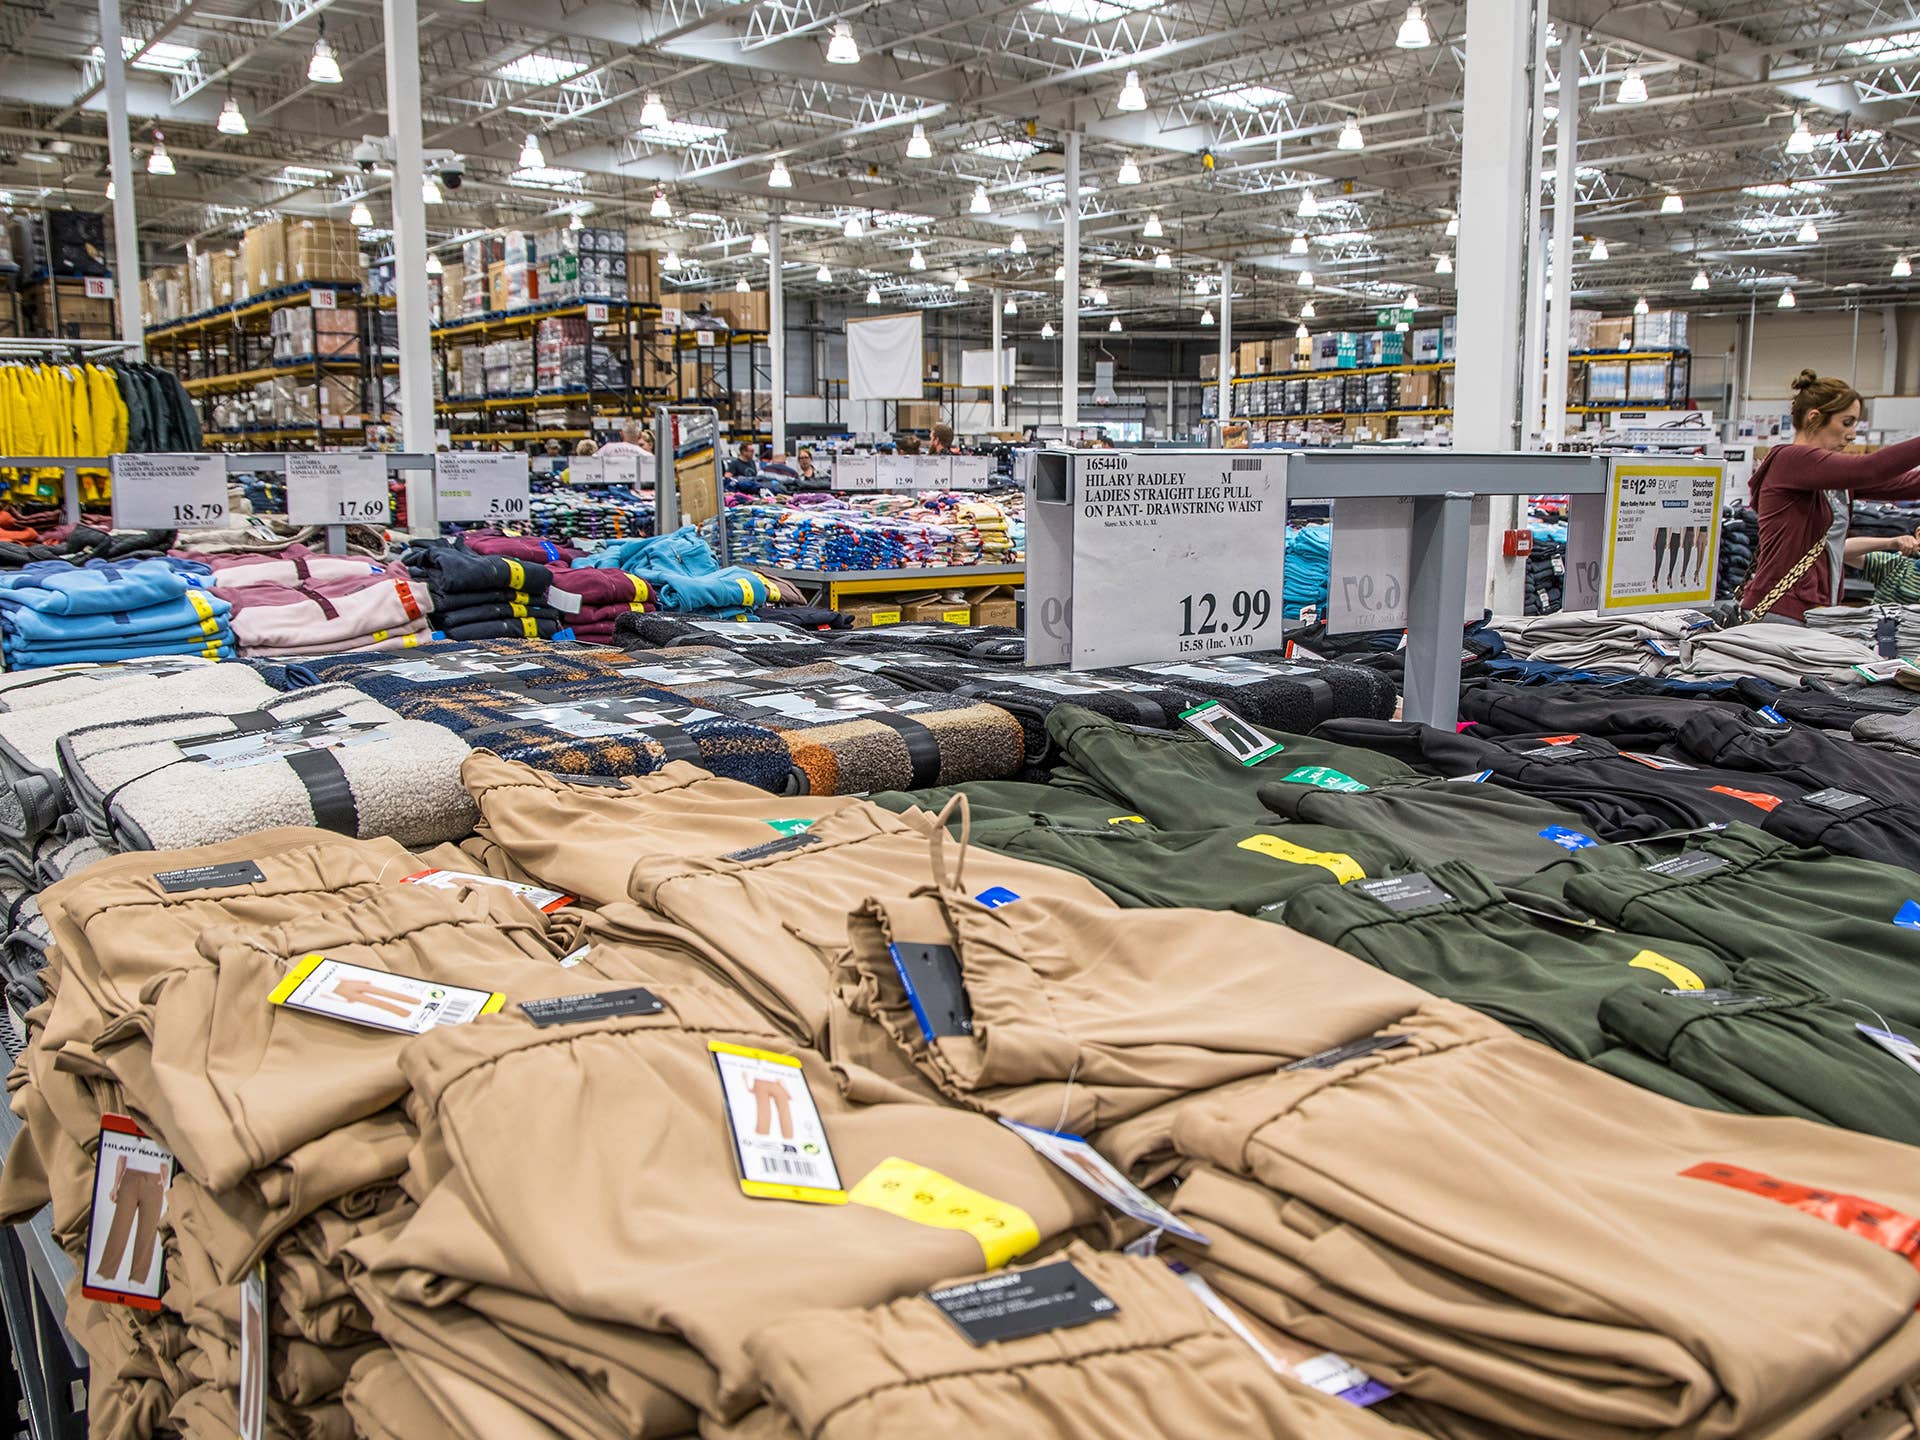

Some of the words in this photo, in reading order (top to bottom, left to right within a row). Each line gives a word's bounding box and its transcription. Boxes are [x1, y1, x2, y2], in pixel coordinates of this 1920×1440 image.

[1086, 458, 1128, 470] 1654410
[1085, 474, 1134, 487] HILARY
[1137, 473, 1186, 486] RADLEY
[1221, 472, 1232, 484] M
[1692, 480, 1715, 488] Voucher
[1085, 489, 1131, 503] LADIES
[1134, 487, 1195, 501] STRAIGHT
[1197, 487, 1220, 499] LEG
[1223, 486, 1252, 498] PULL
[1692, 489, 1713, 498] Savings
[173, 504, 223, 520] 18.79
[338, 500, 383, 516] 17.69
[490, 498, 523, 513] 5.00
[1085, 505, 1103, 518] ON
[1106, 503, 1143, 517] PANT-
[1146, 501, 1225, 515] DRAWSTRING
[1228, 500, 1263, 513] WAIST
[1178, 589, 1271, 637] 12.99
[1179, 639, 1204, 652] 15.58
[1206, 637, 1227, 651] (Inc.
[1230, 634, 1253, 648] VAT)
[1324, 776, 1342, 786] XL
[104, 1142, 136, 1153] HILARY
[139, 1148, 172, 1160] RADLEY
